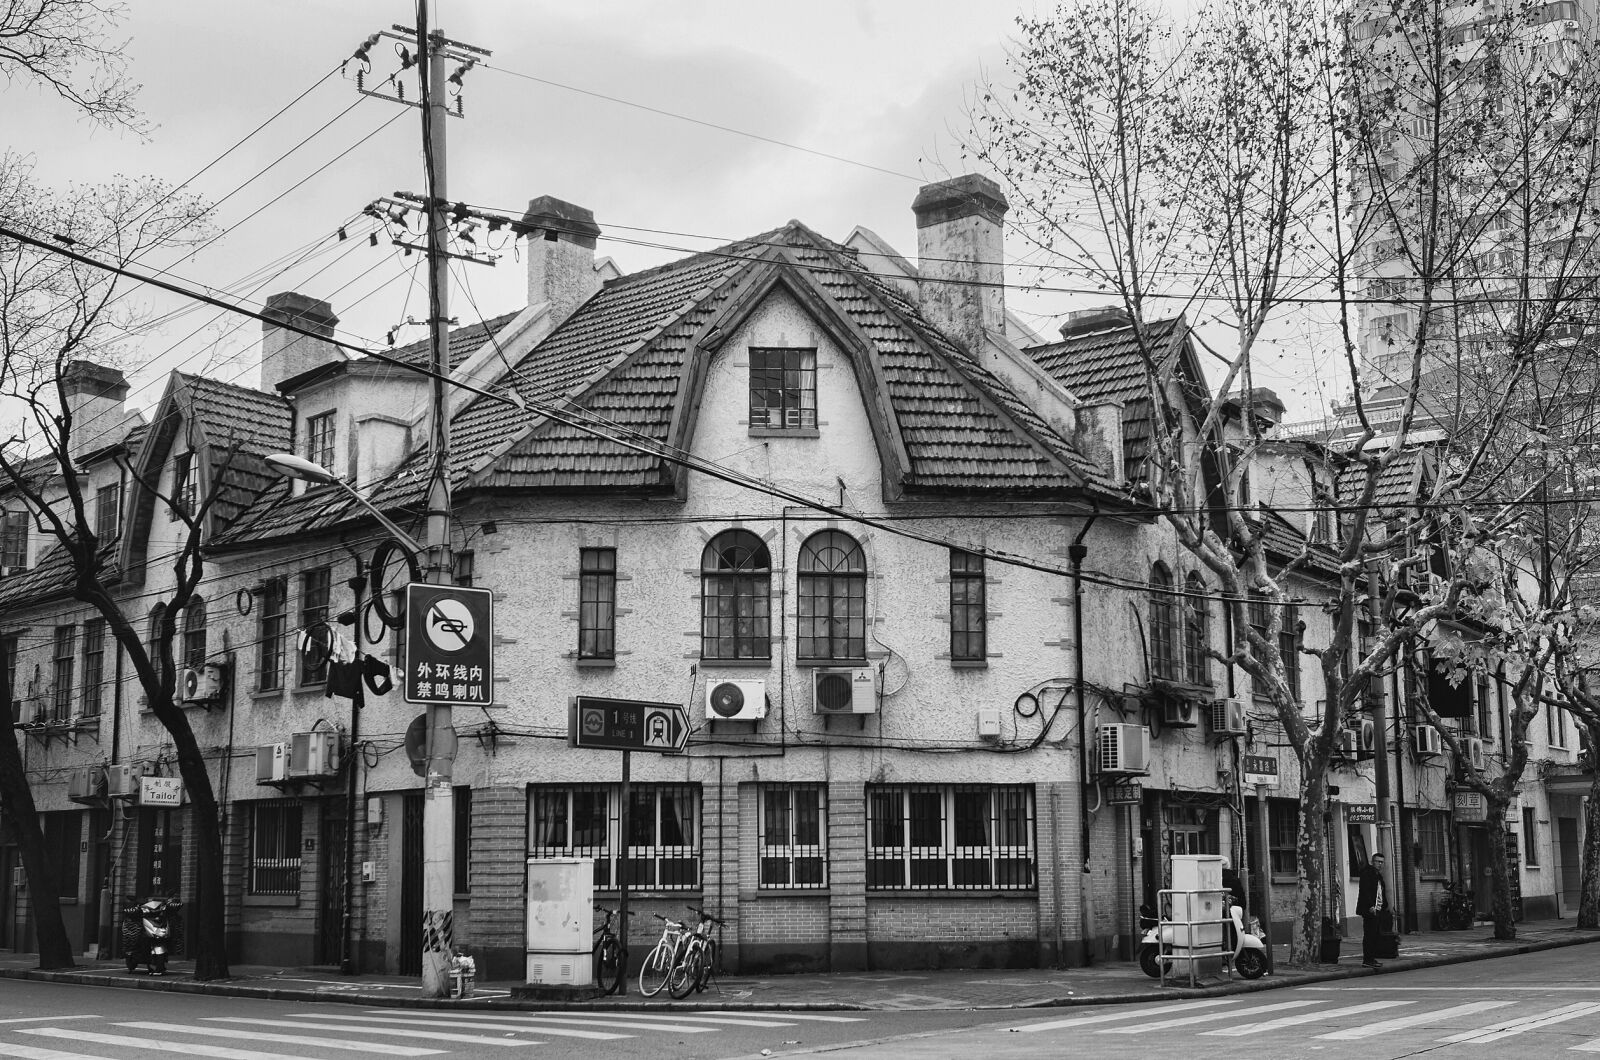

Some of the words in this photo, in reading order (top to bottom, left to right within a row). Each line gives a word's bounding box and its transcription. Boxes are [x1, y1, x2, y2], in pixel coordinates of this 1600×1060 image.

[416, 662, 484, 682] 外环线内
[416, 682, 484, 701] 禁鸣喇叭
[613, 709, 618, 725] 1
[623, 711, 638, 725] 号线
[612, 728, 626, 738] LINE
[150, 791, 177, 800] Tailor
[1456, 793, 1480, 807] 刻章
